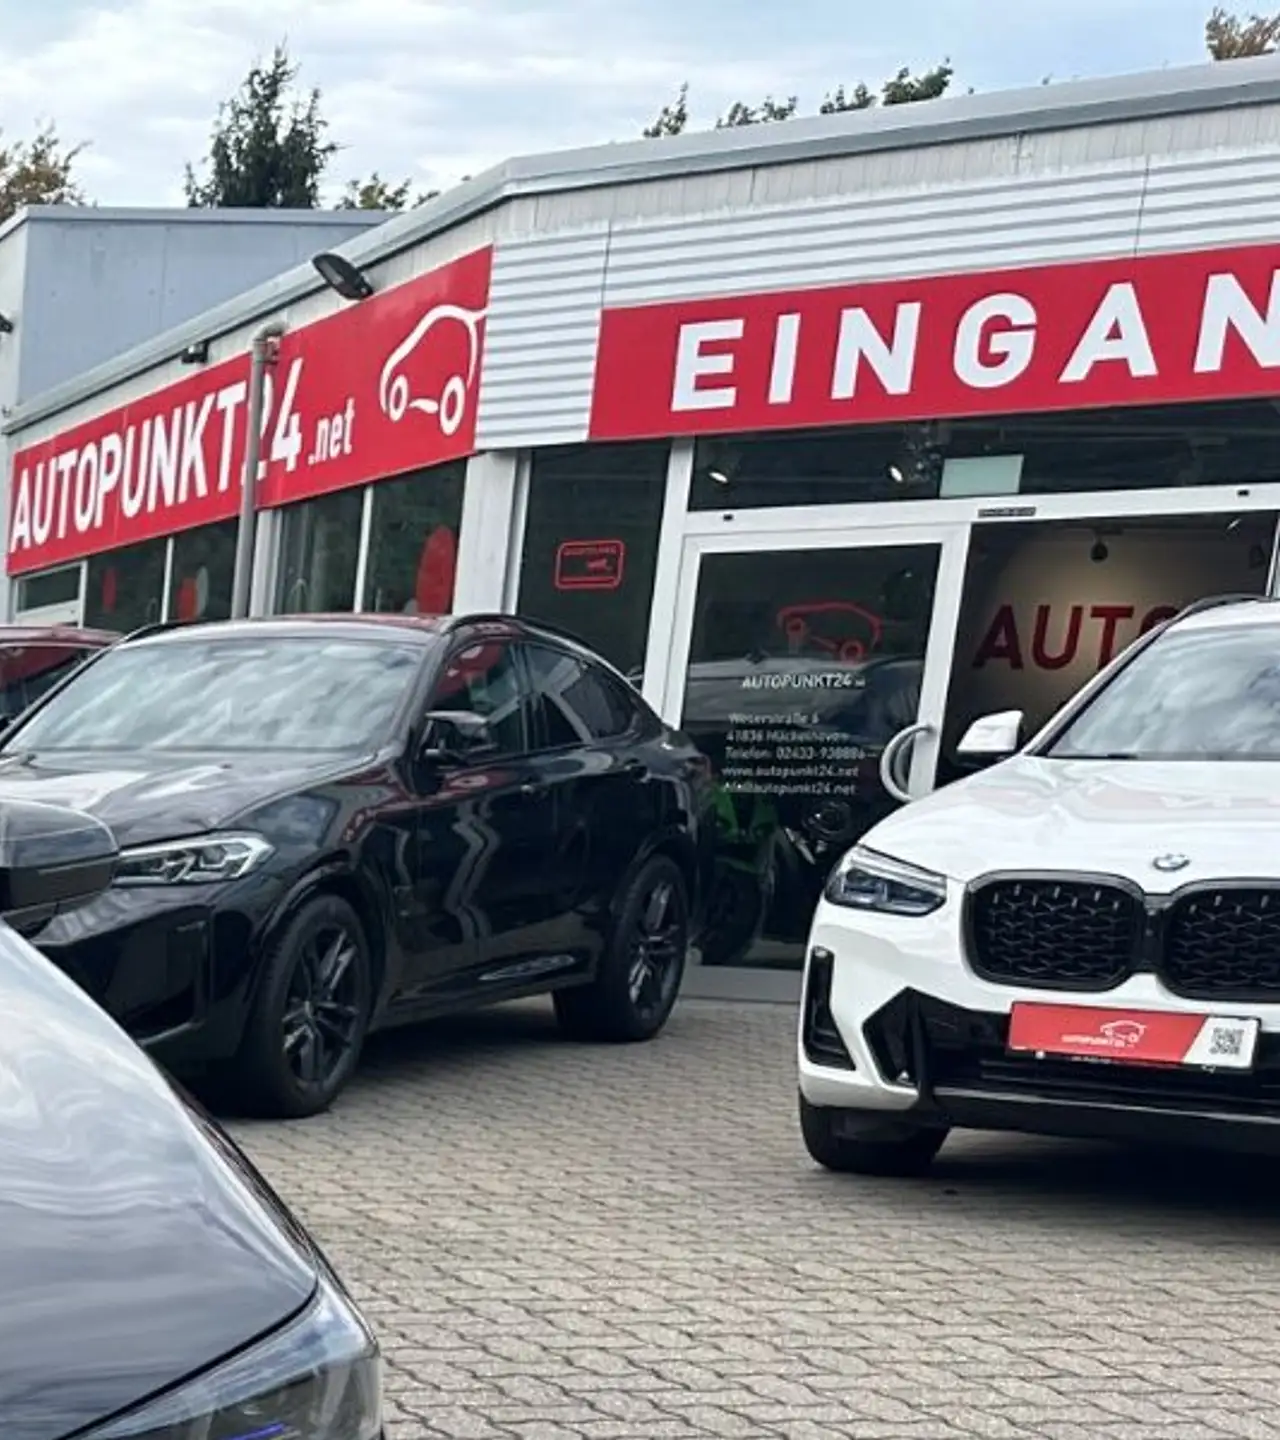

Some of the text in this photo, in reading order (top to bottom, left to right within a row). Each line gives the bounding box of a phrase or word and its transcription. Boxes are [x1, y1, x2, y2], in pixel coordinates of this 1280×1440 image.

[670, 269, 1280, 412] EINGAN
[10, 357, 355, 553] AUTOPUNKT24 .net
[742, 673, 852, 689] AUTOPUNKT24
